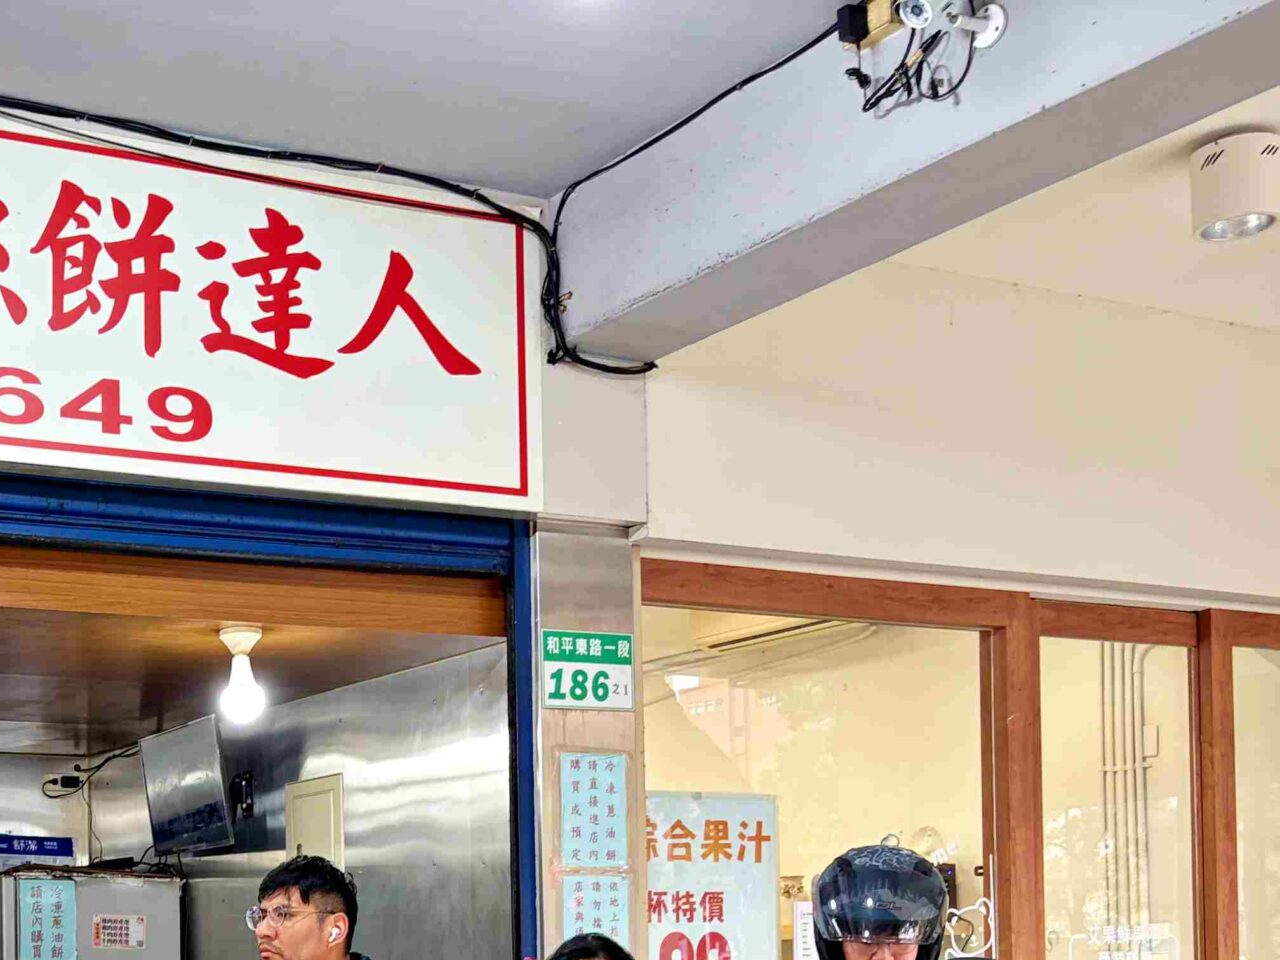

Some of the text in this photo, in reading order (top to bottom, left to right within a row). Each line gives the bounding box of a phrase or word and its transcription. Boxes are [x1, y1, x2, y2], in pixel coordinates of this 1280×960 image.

[546, 636, 630, 658] 和平東路一段
[547, 668, 610, 702] 186
